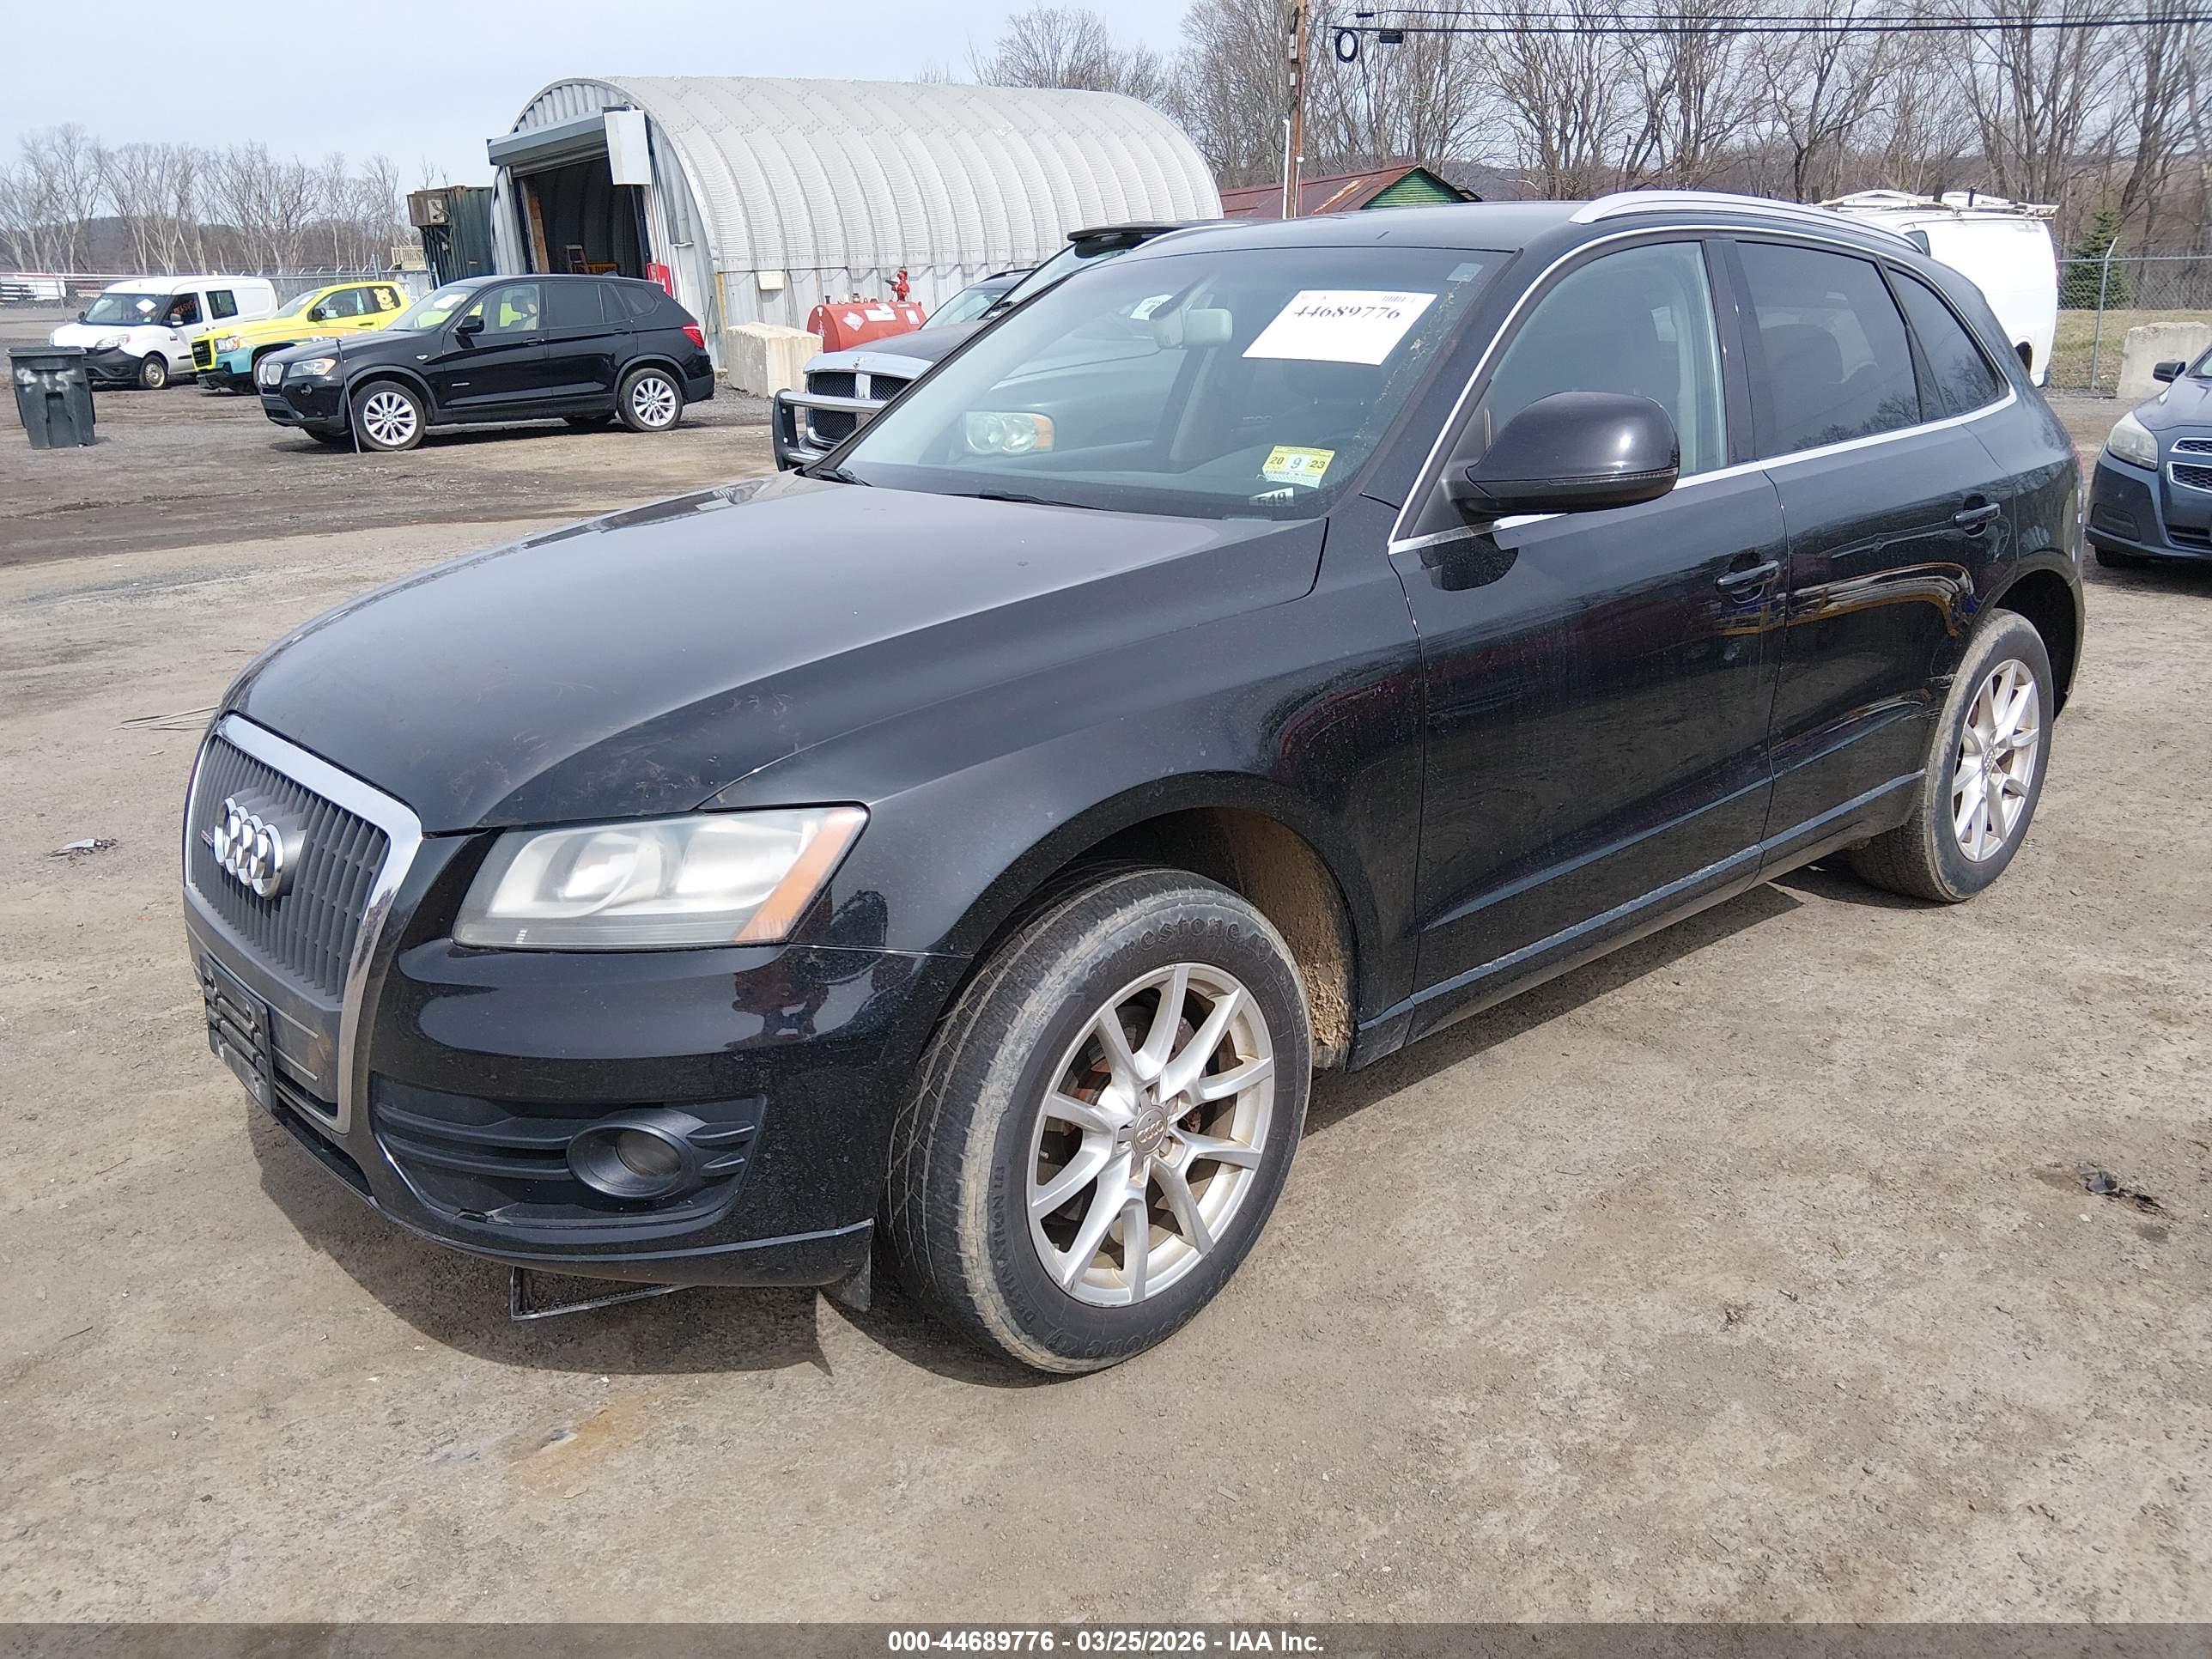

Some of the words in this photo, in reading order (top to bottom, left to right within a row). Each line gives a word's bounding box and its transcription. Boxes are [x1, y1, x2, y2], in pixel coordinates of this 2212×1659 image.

[1293, 305, 1401, 319] 44689776
[1269, 456, 1285, 465] 20
[1290, 457, 1302, 469] 9
[1309, 460, 1326, 469] 23
[1086, 915, 1240, 981] Firestone
[988, 1194, 1036, 1327] DESTINATION
